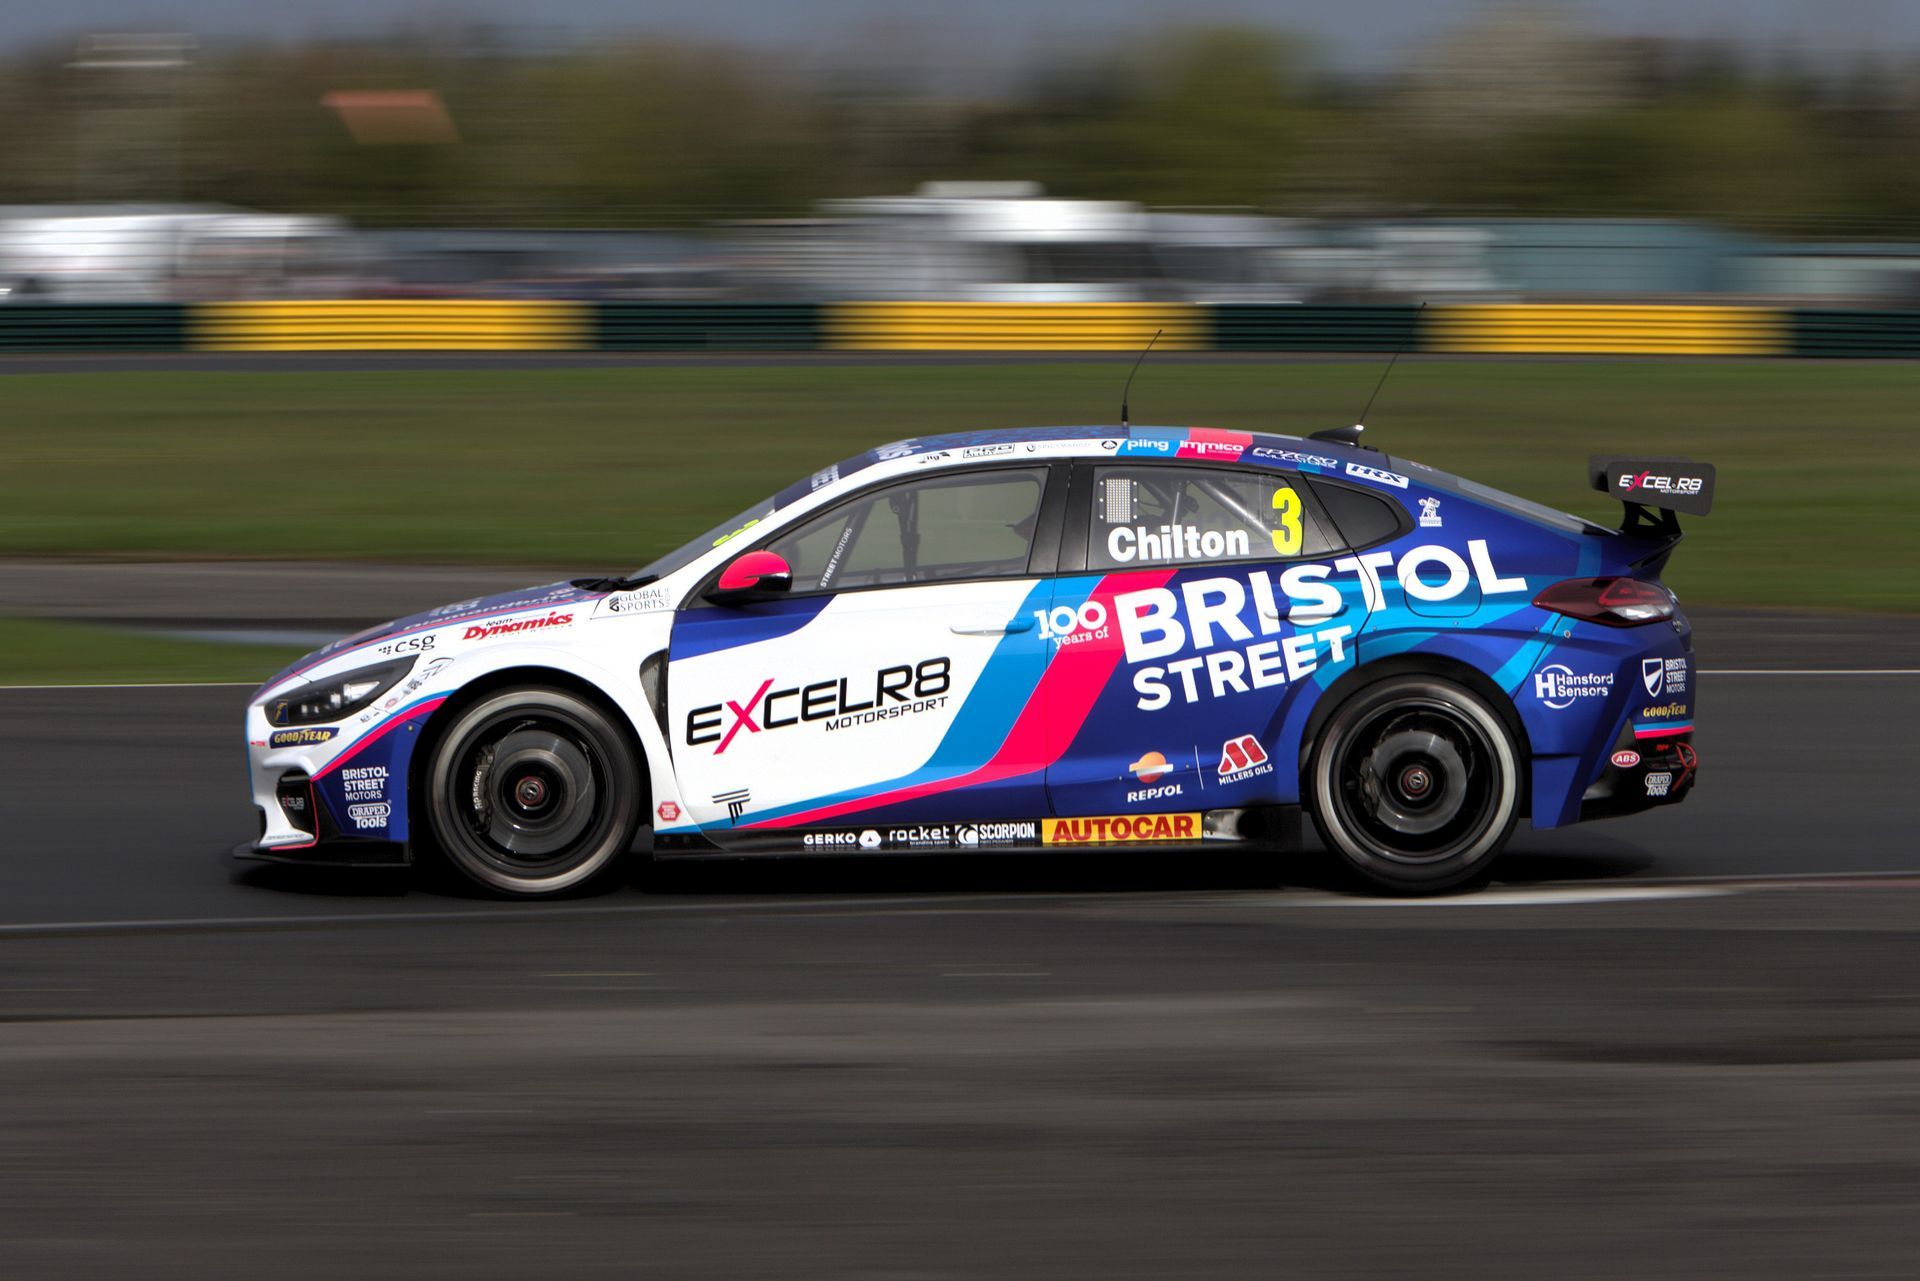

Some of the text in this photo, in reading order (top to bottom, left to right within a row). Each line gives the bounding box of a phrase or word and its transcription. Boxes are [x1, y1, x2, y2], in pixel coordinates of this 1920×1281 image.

[1618, 470, 1703, 492] EXCELR8
[1272, 488, 1303, 555] 3
[1108, 523, 1249, 562] Chilton
[820, 527, 853, 588] STREET MOTORS
[620, 588, 663, 601] GLOBAL
[1114, 539, 1528, 664] BRISTOL
[620, 600, 664, 611] SPORTS
[462, 611, 574, 641] Dynamics
[1034, 601, 1107, 640] 100
[395, 634, 436, 654] csg
[1053, 626, 1109, 650] years of
[1133, 626, 1353, 710] STREET
[1665, 658, 1687, 671] BRISTOL
[1556, 673, 1614, 685] Hansford
[1666, 670, 1686, 683] STREET
[1558, 685, 1609, 697] Sensors
[1666, 683, 1686, 693] MOTORS
[686, 656, 951, 755] EXCELR8
[826, 696, 949, 731] MOTORSPORT
[1643, 702, 1687, 719] GOODYEAR
[274, 728, 331, 744] GOODYEAR
[1616, 753, 1637, 763] ABS
[342, 766, 389, 780] BRISTOL
[1218, 764, 1274, 786] MILLERS OILS
[1647, 775, 1670, 784] DRAPER
[343, 779, 385, 791] STREET
[1127, 784, 1183, 803] REPSOL
[345, 790, 382, 801] MOTORS
[352, 805, 386, 817] DRAPER
[889, 825, 950, 842] rocket
[979, 823, 1035, 839] SCORPION
[1051, 815, 1195, 842] AUTOCAR
[804, 833, 857, 845] GERKO
